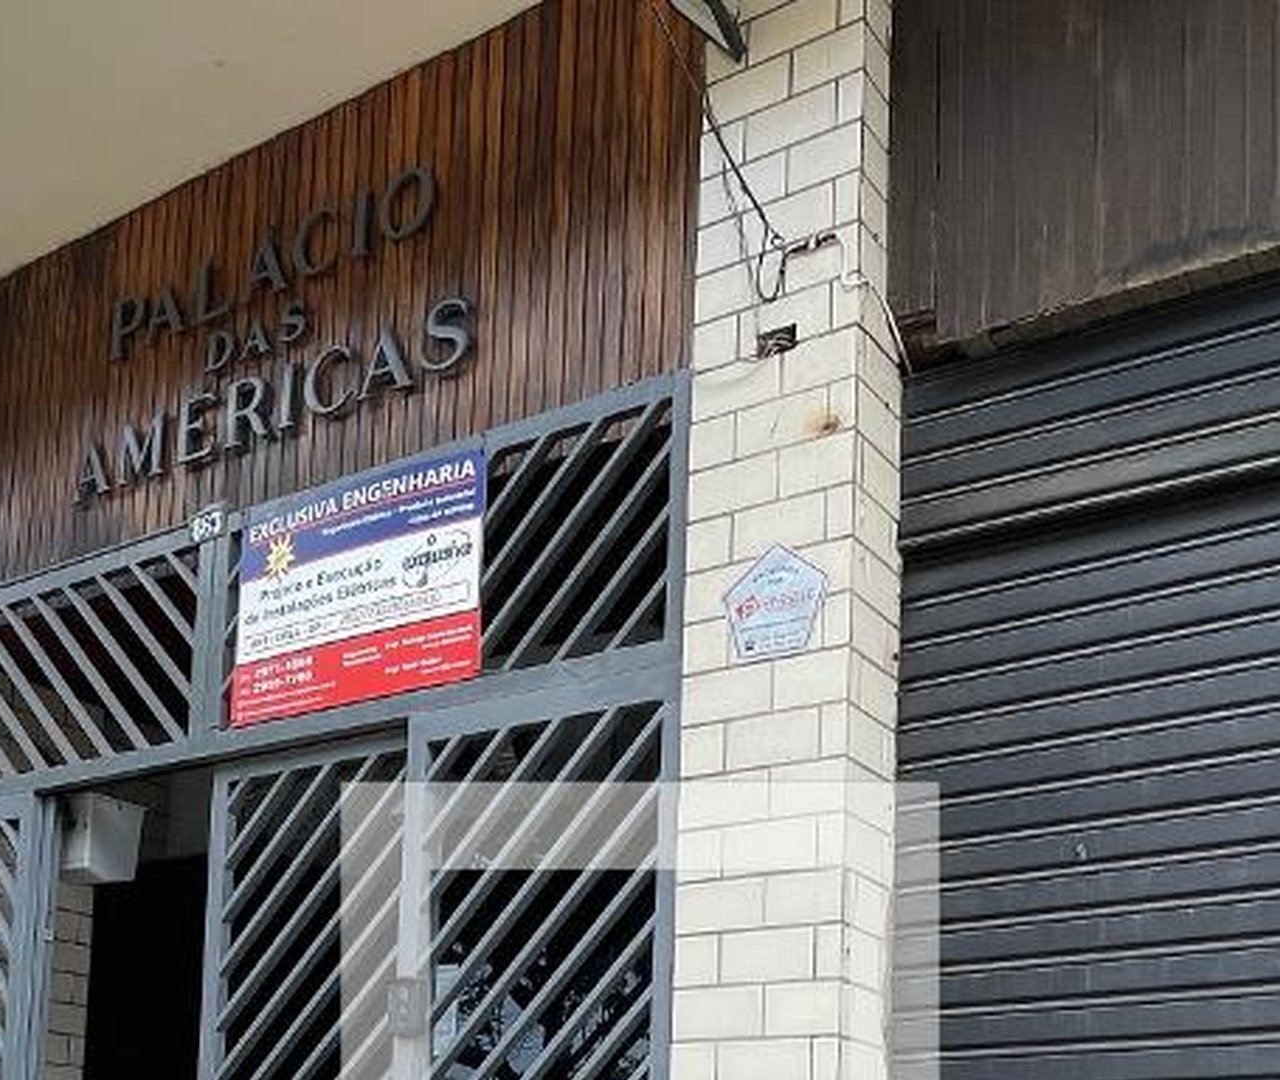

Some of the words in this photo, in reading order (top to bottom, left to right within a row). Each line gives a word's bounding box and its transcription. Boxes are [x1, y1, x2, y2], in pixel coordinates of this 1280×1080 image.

[205, 298, 309, 375] DAS
[250, 496, 340, 544] EXCLUSIVA
[341, 459, 476, 512] ENGENHARIA
